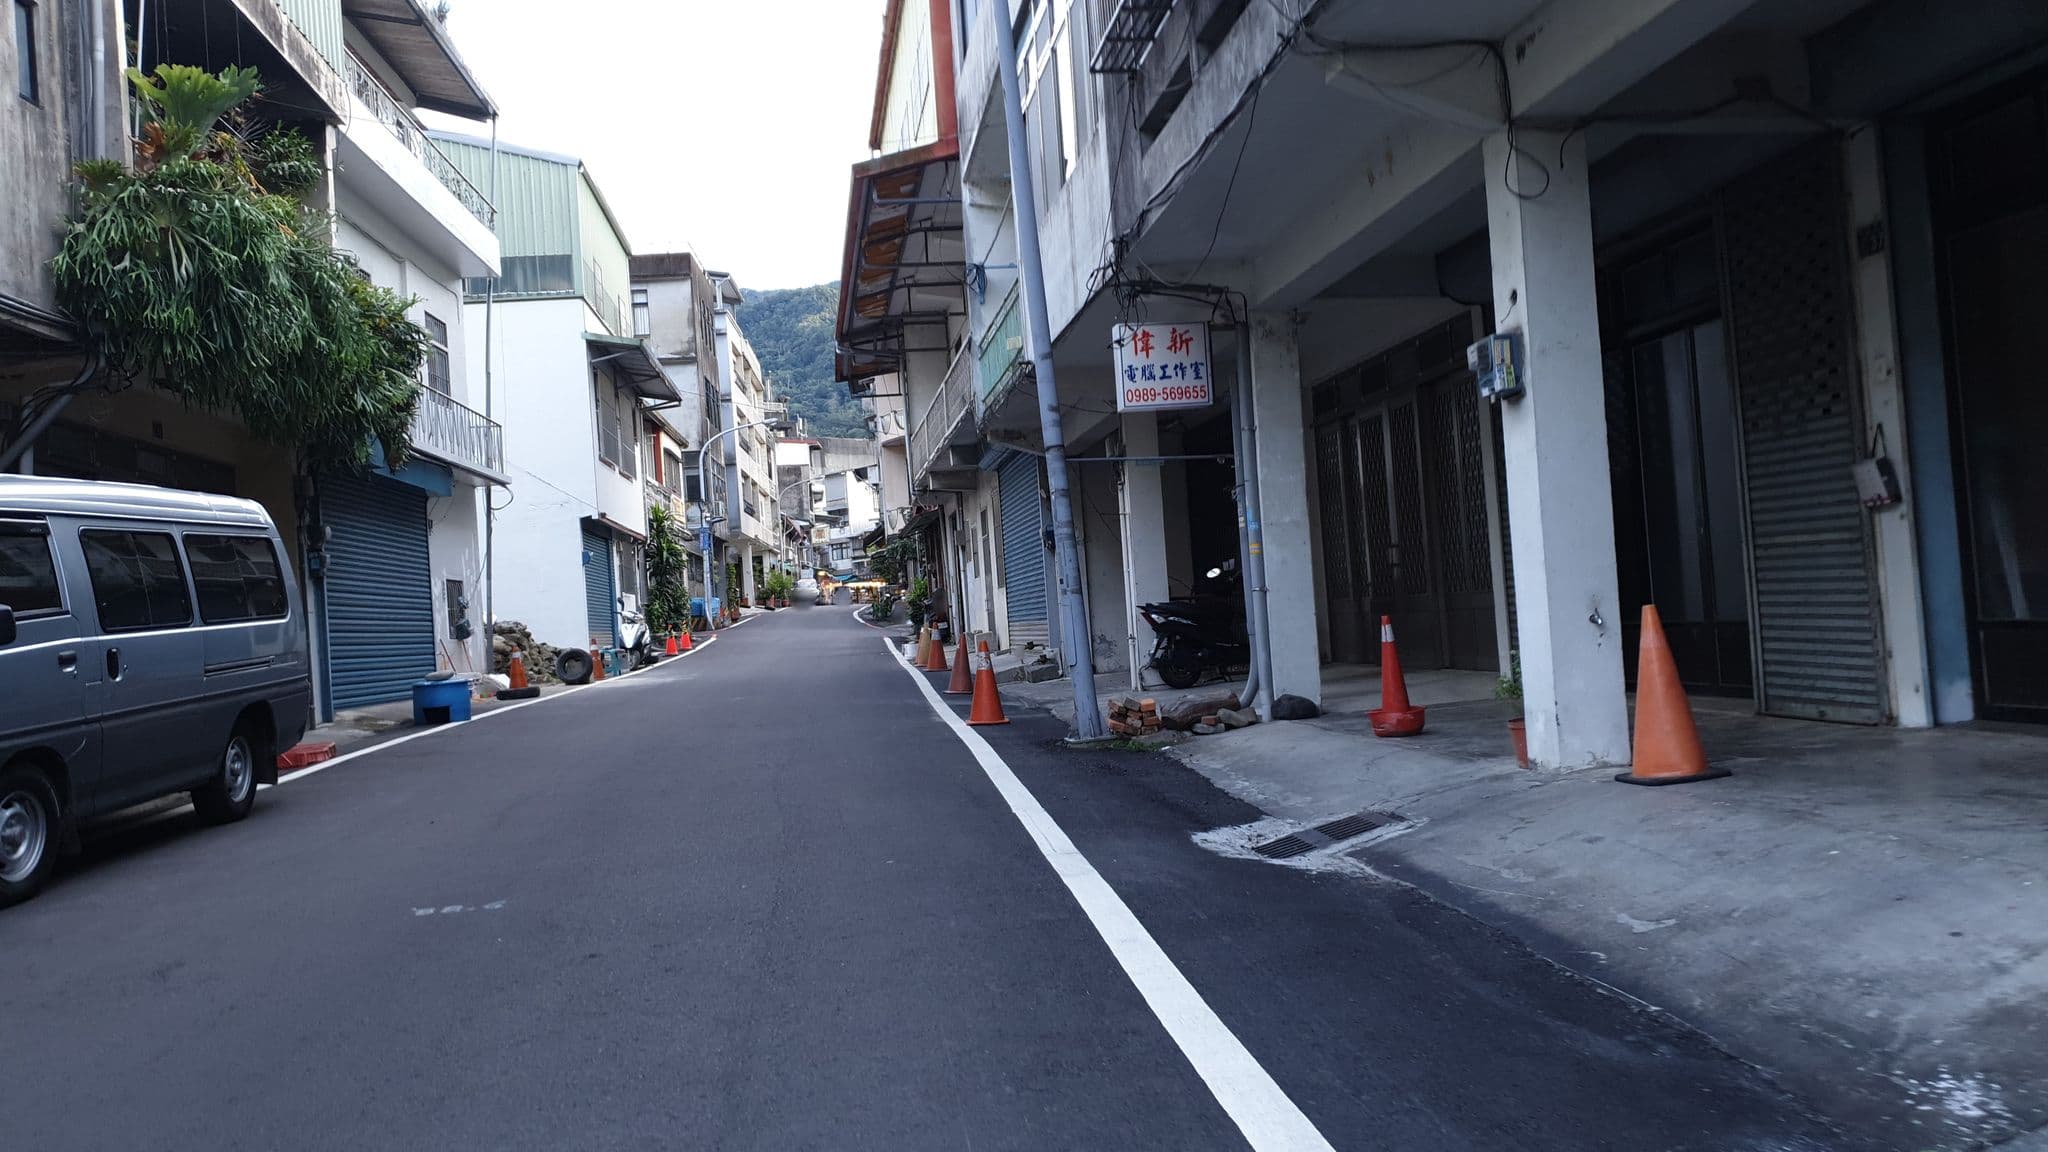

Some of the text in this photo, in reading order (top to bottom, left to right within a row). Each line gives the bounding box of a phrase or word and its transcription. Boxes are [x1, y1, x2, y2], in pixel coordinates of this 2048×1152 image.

[1124, 361, 1204, 383] 電腦工作室
[1126, 385, 1207, 403] 0989-569655
